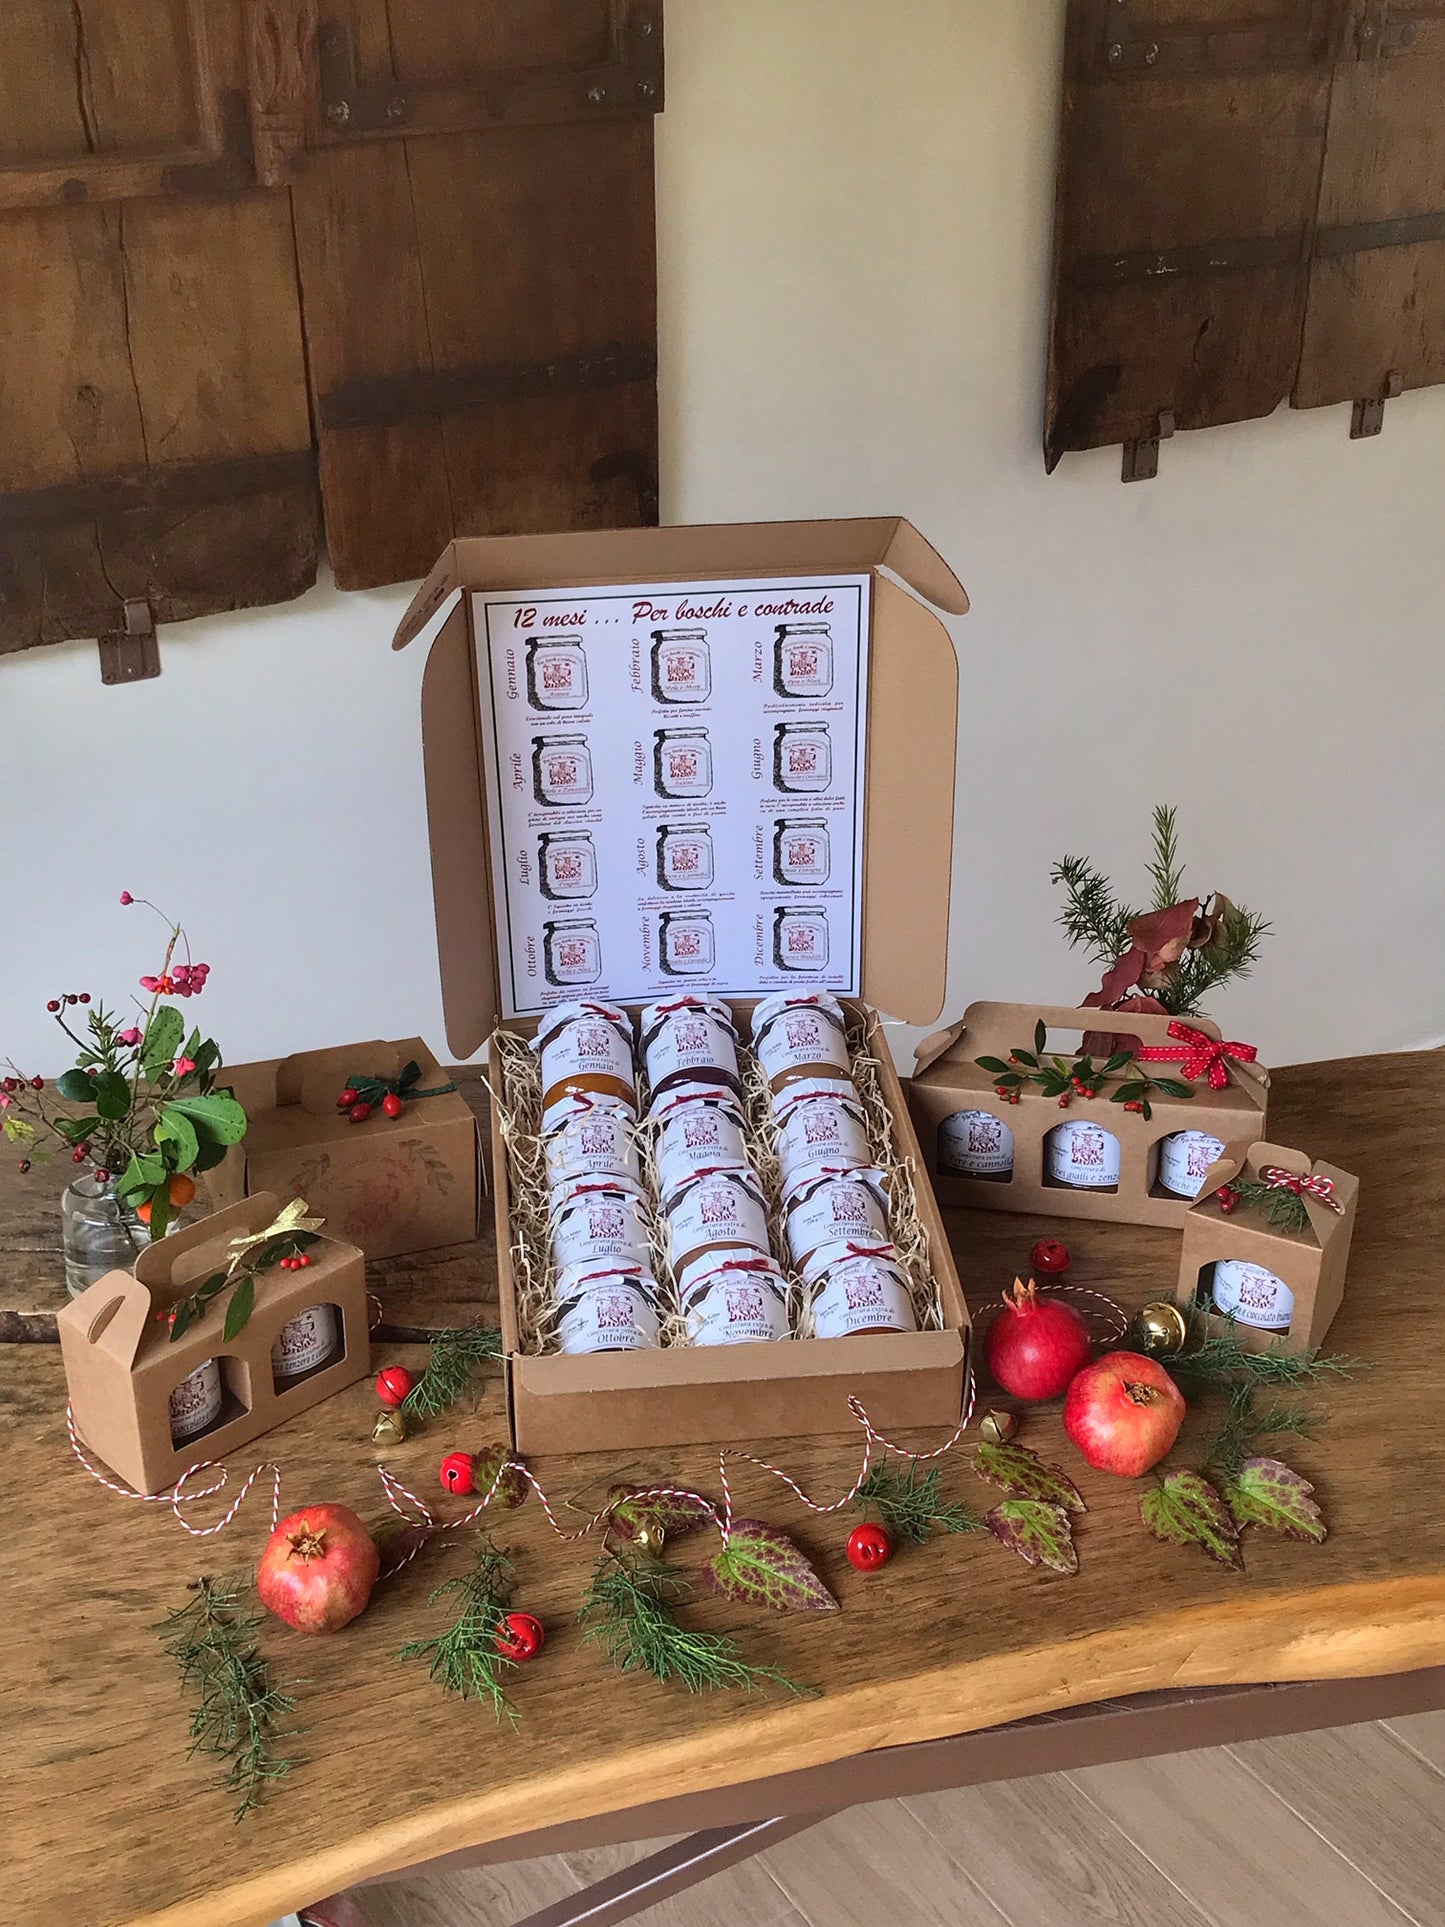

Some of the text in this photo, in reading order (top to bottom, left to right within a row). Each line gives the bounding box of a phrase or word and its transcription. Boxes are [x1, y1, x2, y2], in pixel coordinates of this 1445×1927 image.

[513, 608, 537, 628] 12
[542, 609, 587, 627] mesi
[631, 601, 669, 624] Per
[675, 597, 732, 620] boschi
[738, 605, 748, 617] e
[754, 594, 834, 617] contrade
[506, 649, 520, 700] Gennaio
[629, 638, 643, 694] Febbraio
[753, 641, 763, 683] Marzo
[513, 753, 527, 791] Aprile
[634, 741, 647, 785] Maggio
[752, 738, 765, 780] Giugno
[517, 850, 532, 885] Luglio
[637, 838, 649, 876] Agosto
[752, 824, 764, 880] Settembre
[525, 936, 537, 977] Ottobre
[637, 916, 651, 972] Novembre
[752, 914, 764, 966] Dicembre
[578, 1062, 614, 1071] Gennaio
[794, 1052, 821, 1061] Marzo
[584, 1160, 614, 1169] Aprile
[808, 1147, 840, 1158] Giugno
[592, 1244, 621, 1255] Luglio
[704, 1227, 736, 1240] Agosto
[829, 1227, 873, 1237] Settembre
[597, 1333, 635, 1343] Ottobre
[723, 1328, 773, 1339] Novembre
[845, 1313, 892, 1328] Dicembre
